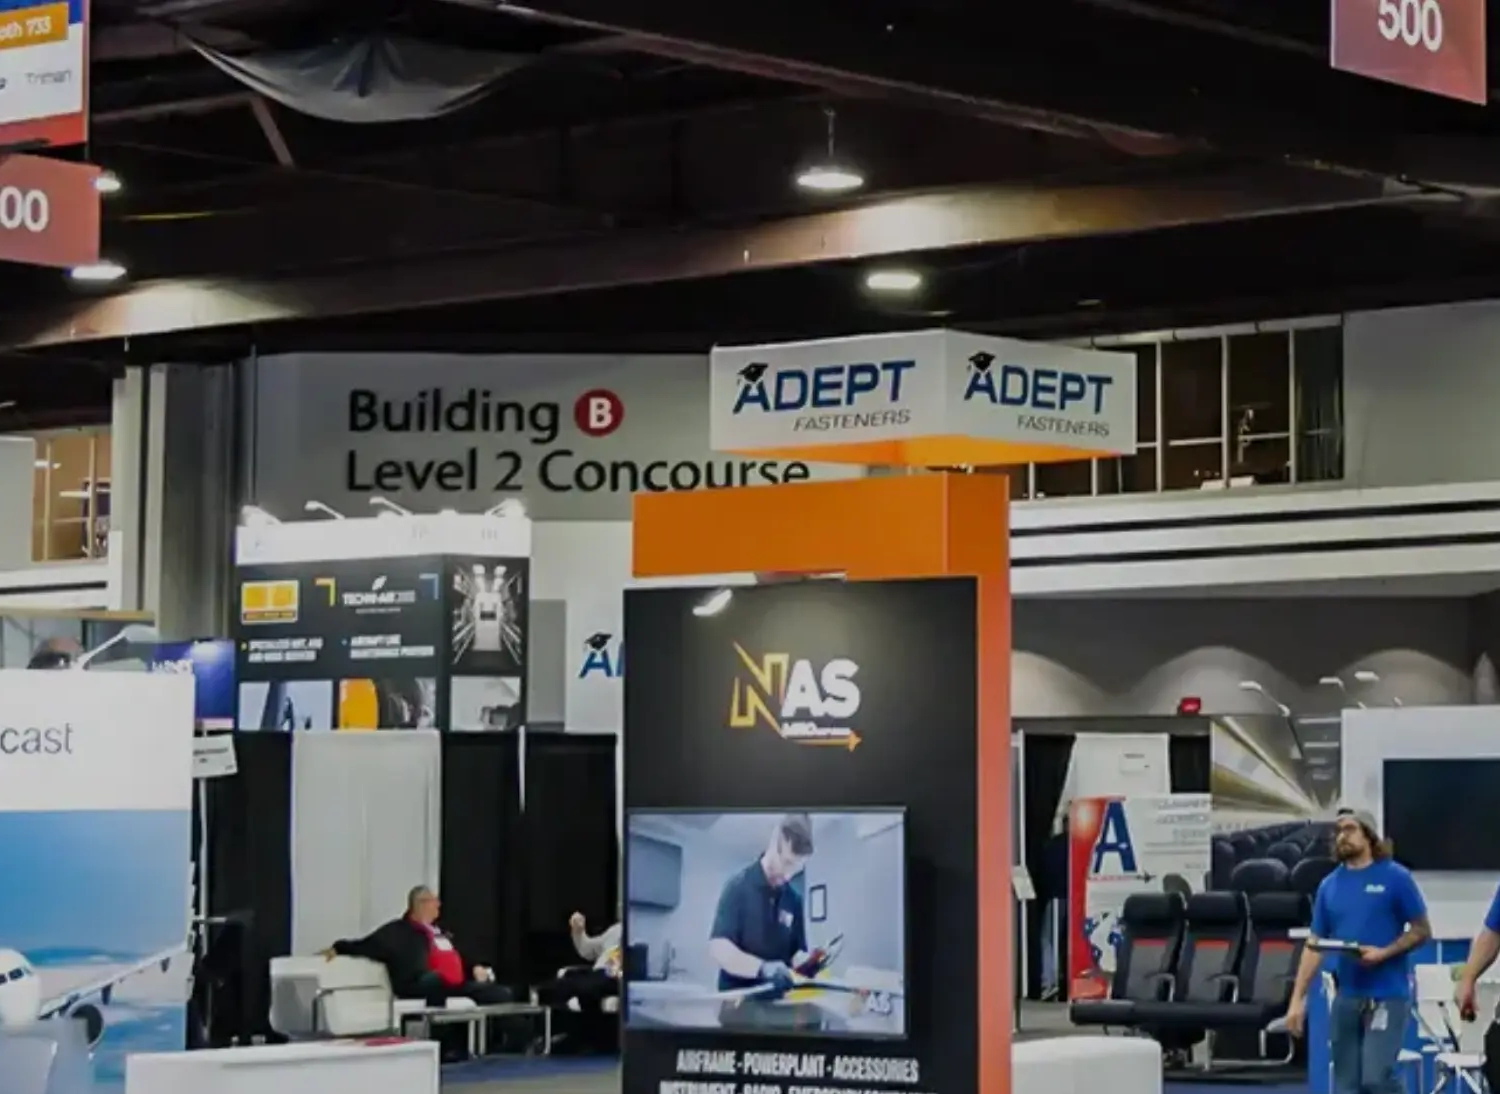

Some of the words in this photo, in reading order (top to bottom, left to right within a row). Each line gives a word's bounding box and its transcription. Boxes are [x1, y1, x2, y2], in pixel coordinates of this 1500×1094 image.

[1377, 0, 1443, 52] 500
[732, 359, 916, 415] ADEPT
[964, 362, 1113, 416] ADEPT
[348, 388, 561, 445] Building
[587, 396, 613, 430] B
[793, 409, 911, 432] FASTENERS
[1016, 414, 1111, 437] FASTENERS
[346, 447, 479, 492] Level
[494, 450, 524, 492] 2
[537, 450, 812, 493] Concourse
[675, 1048, 737, 1074] AIRFRAME
[743, 1051, 827, 1079] POWERPLANT
[832, 1055, 920, 1084] ACCESSORIES
